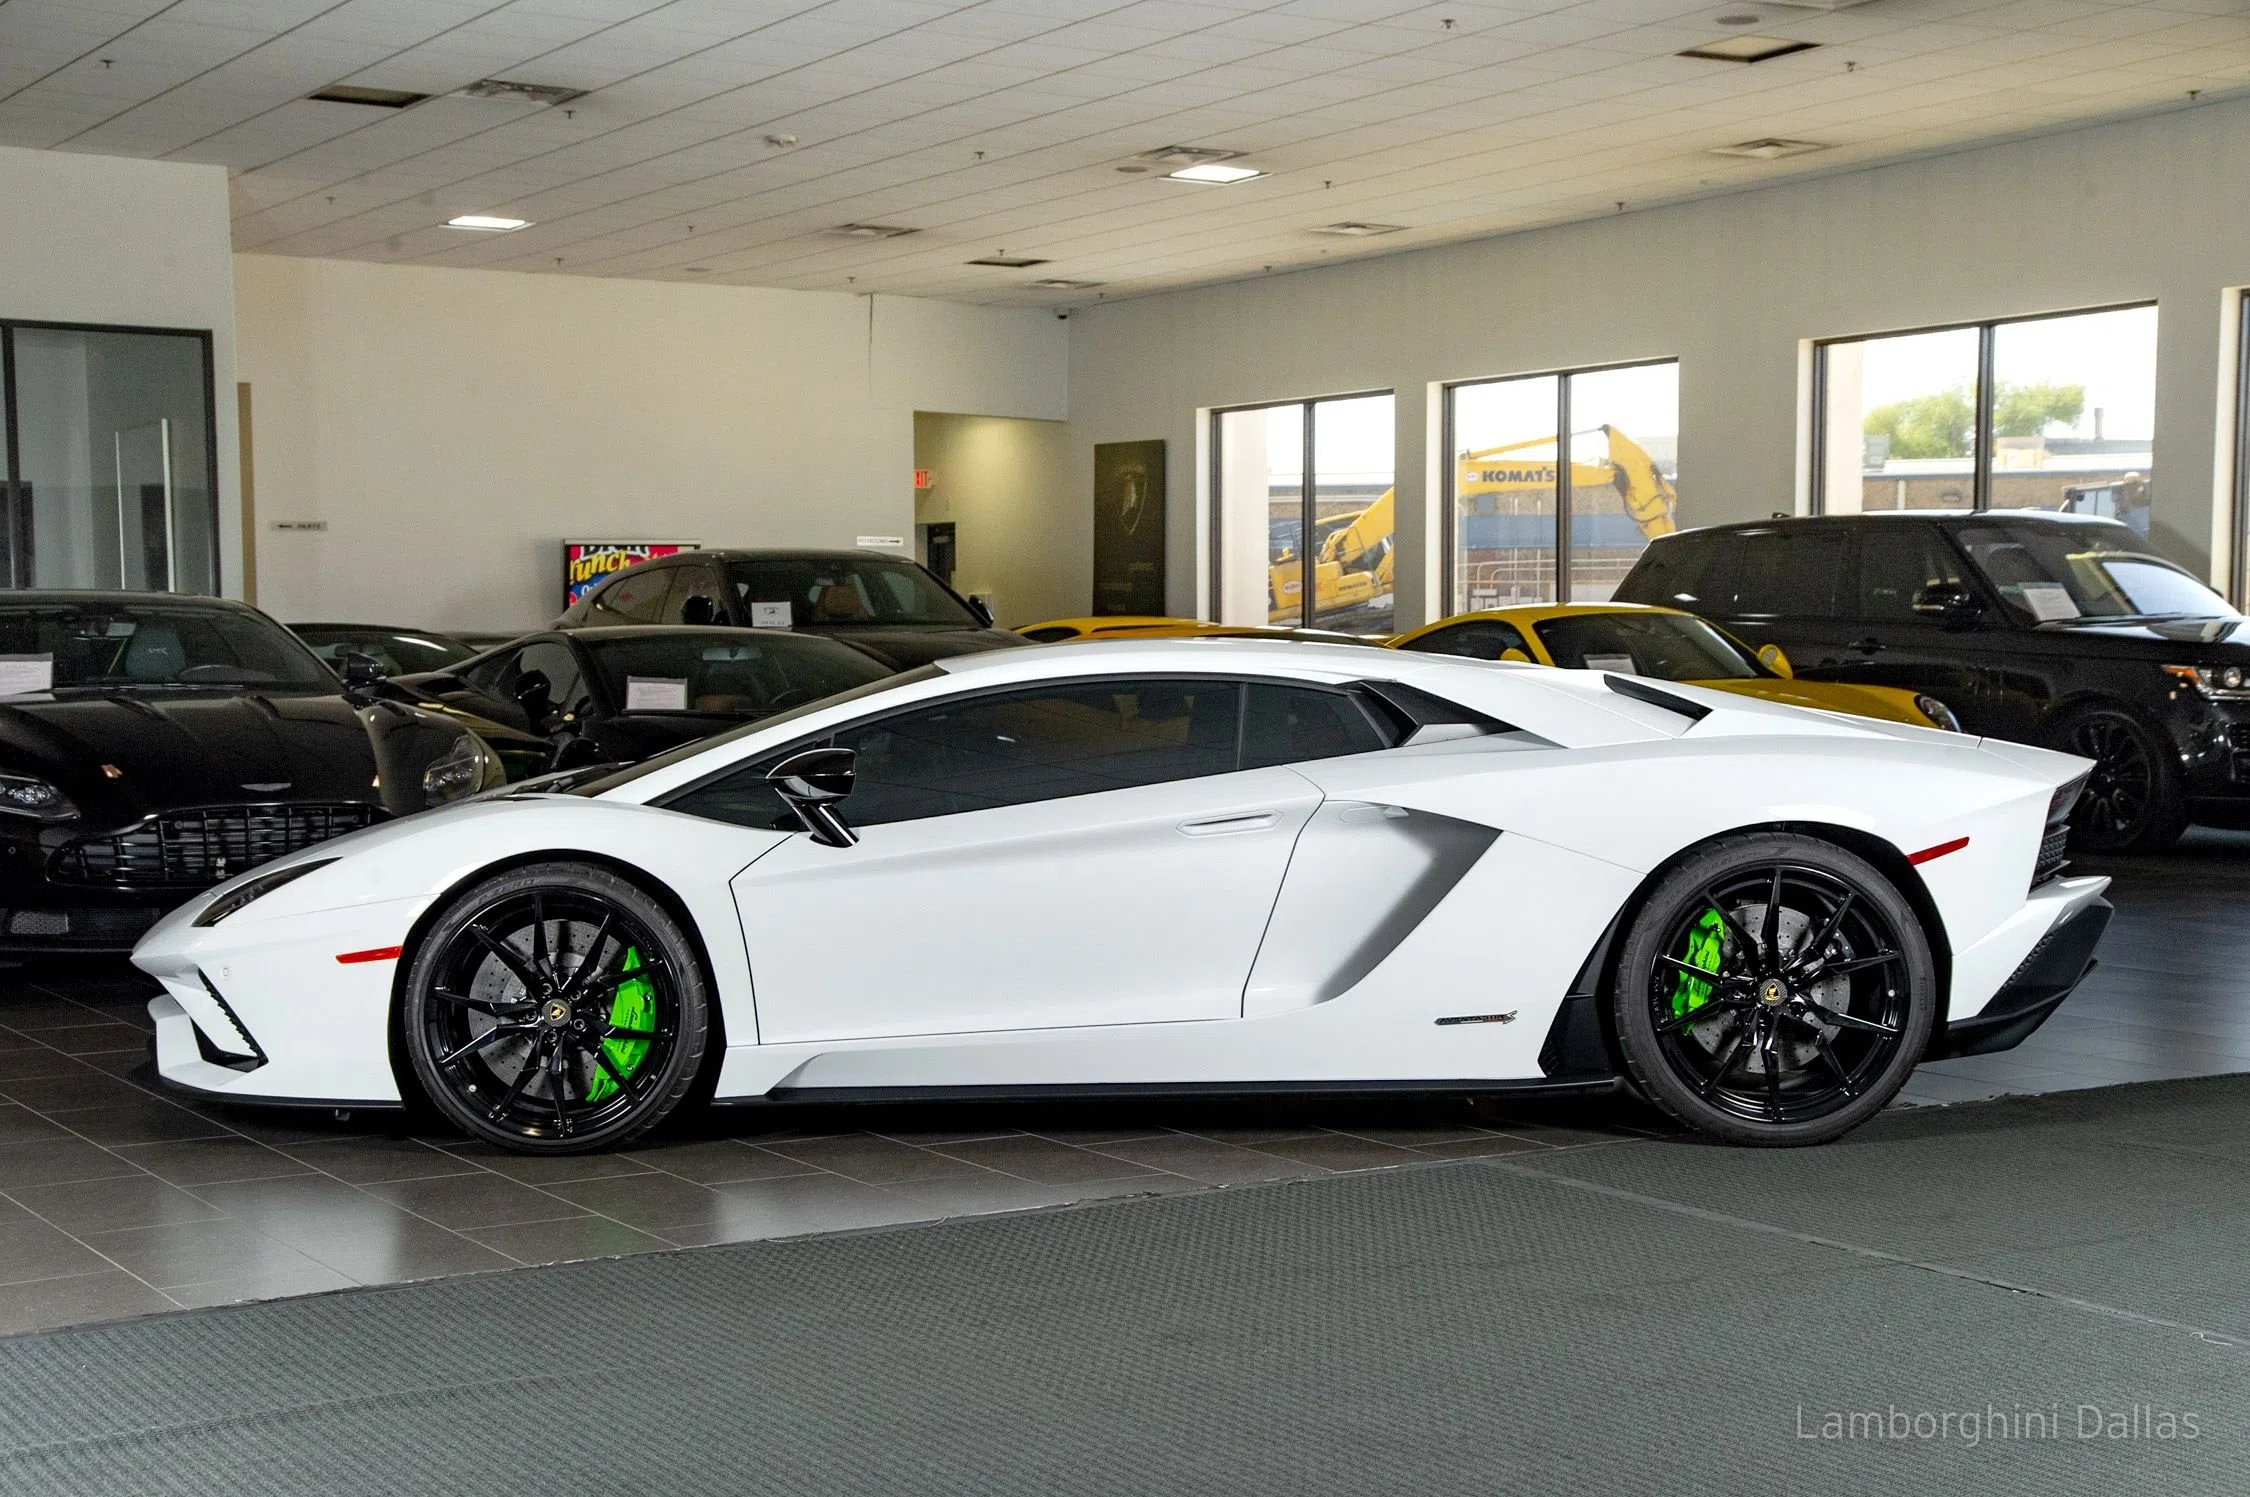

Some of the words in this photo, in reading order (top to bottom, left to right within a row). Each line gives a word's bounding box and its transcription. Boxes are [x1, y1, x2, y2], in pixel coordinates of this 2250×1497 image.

[915, 470, 928, 487] XIT
[1482, 467, 1555, 482] KOMATS
[570, 549, 630, 583] runch
